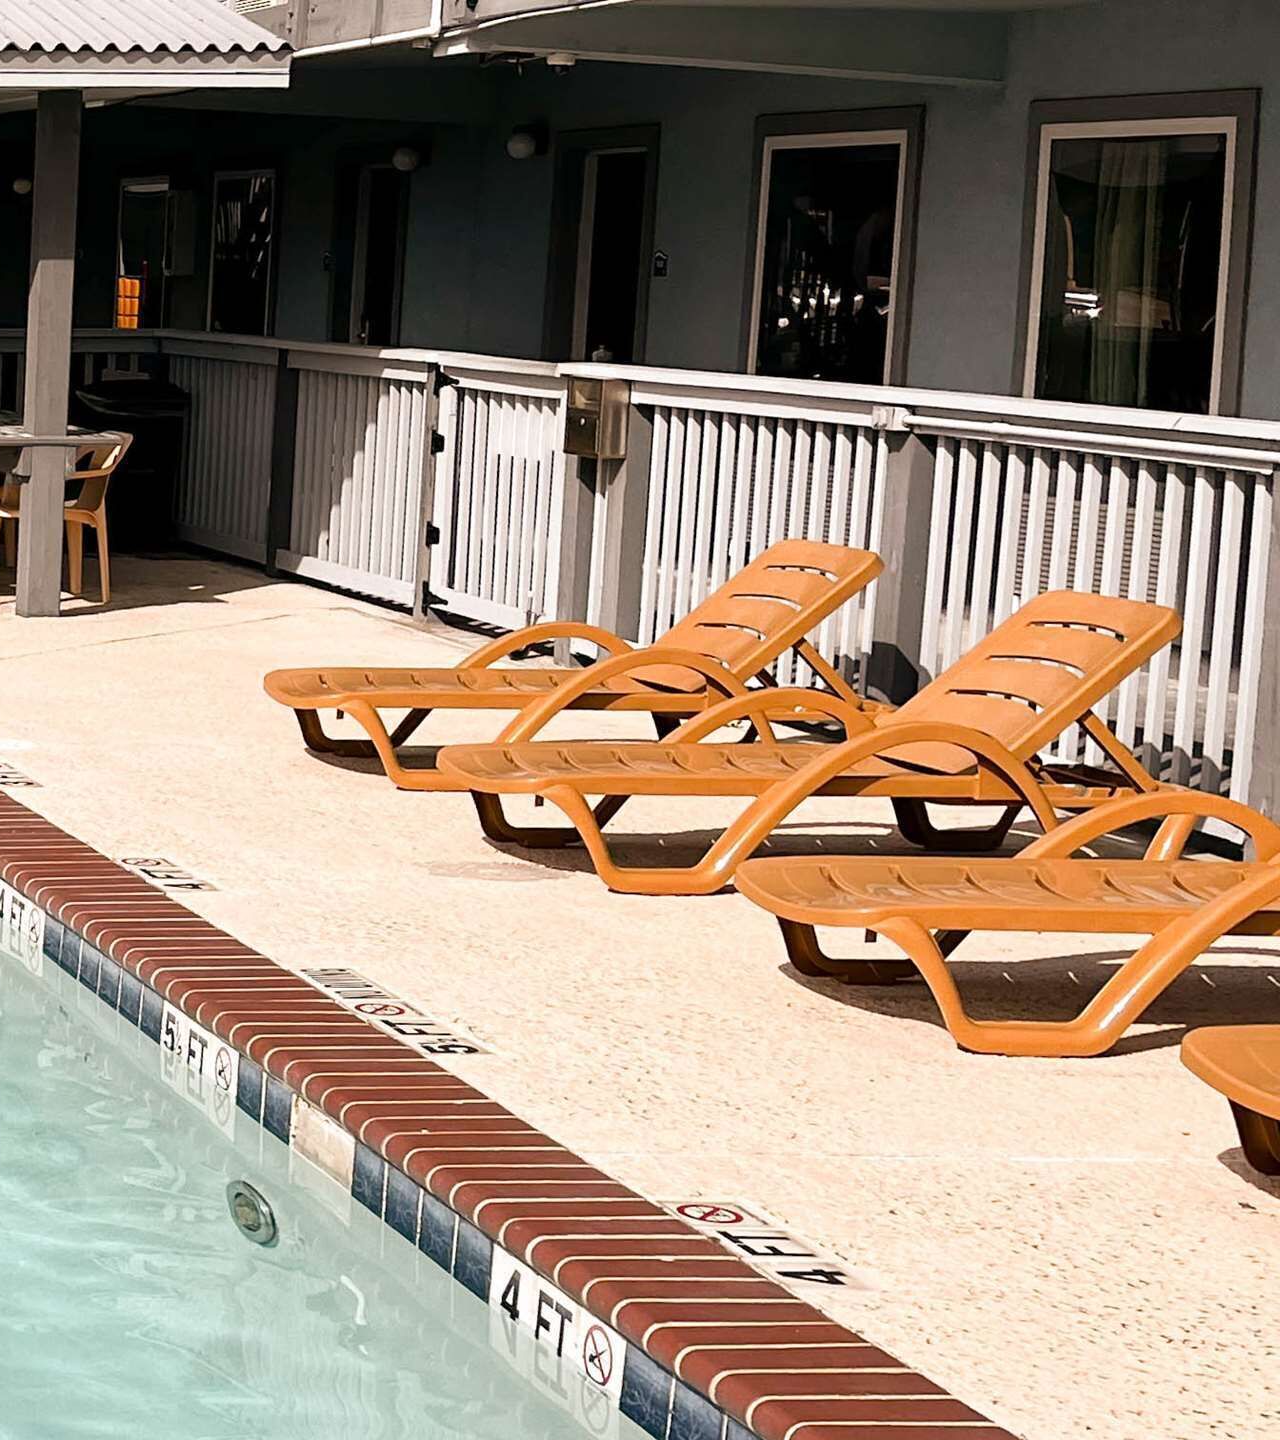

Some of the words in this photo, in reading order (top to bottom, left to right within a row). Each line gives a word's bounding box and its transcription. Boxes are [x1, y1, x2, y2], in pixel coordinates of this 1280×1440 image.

[9, 895, 25, 931] FT
[380, 1019, 452, 1036] FT
[187, 1028, 208, 1076] FT
[716, 1230, 820, 1257] FT
[776, 1267, 848, 1286] 4
[500, 1269, 521, 1321] 4
[535, 1289, 573, 1358] FT
